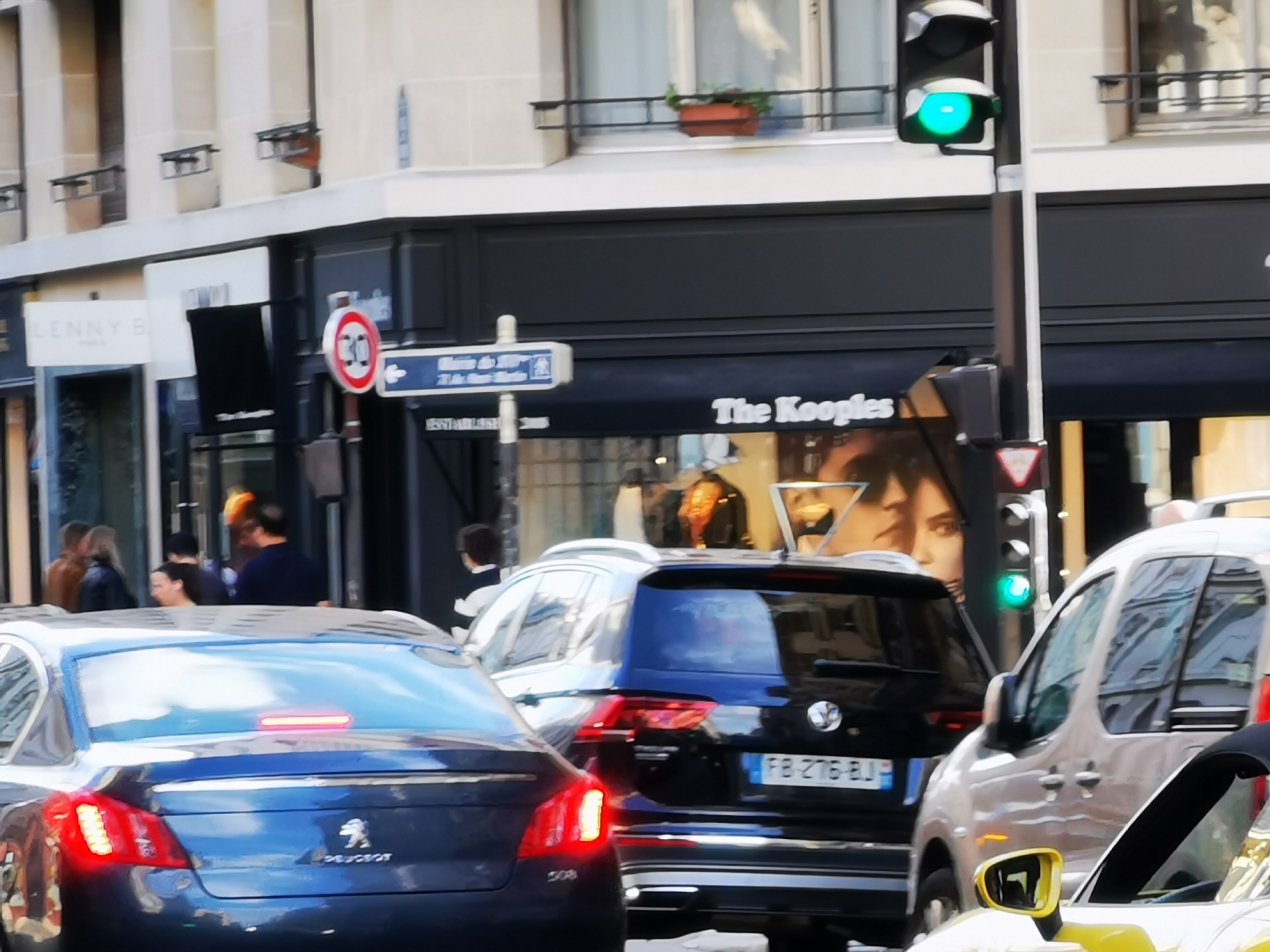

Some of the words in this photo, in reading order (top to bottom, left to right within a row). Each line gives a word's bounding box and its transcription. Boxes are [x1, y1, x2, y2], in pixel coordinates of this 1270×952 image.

[34, 319, 122, 339] LENNY
[711, 397, 772, 424] The
[775, 393, 895, 426] Kooples
